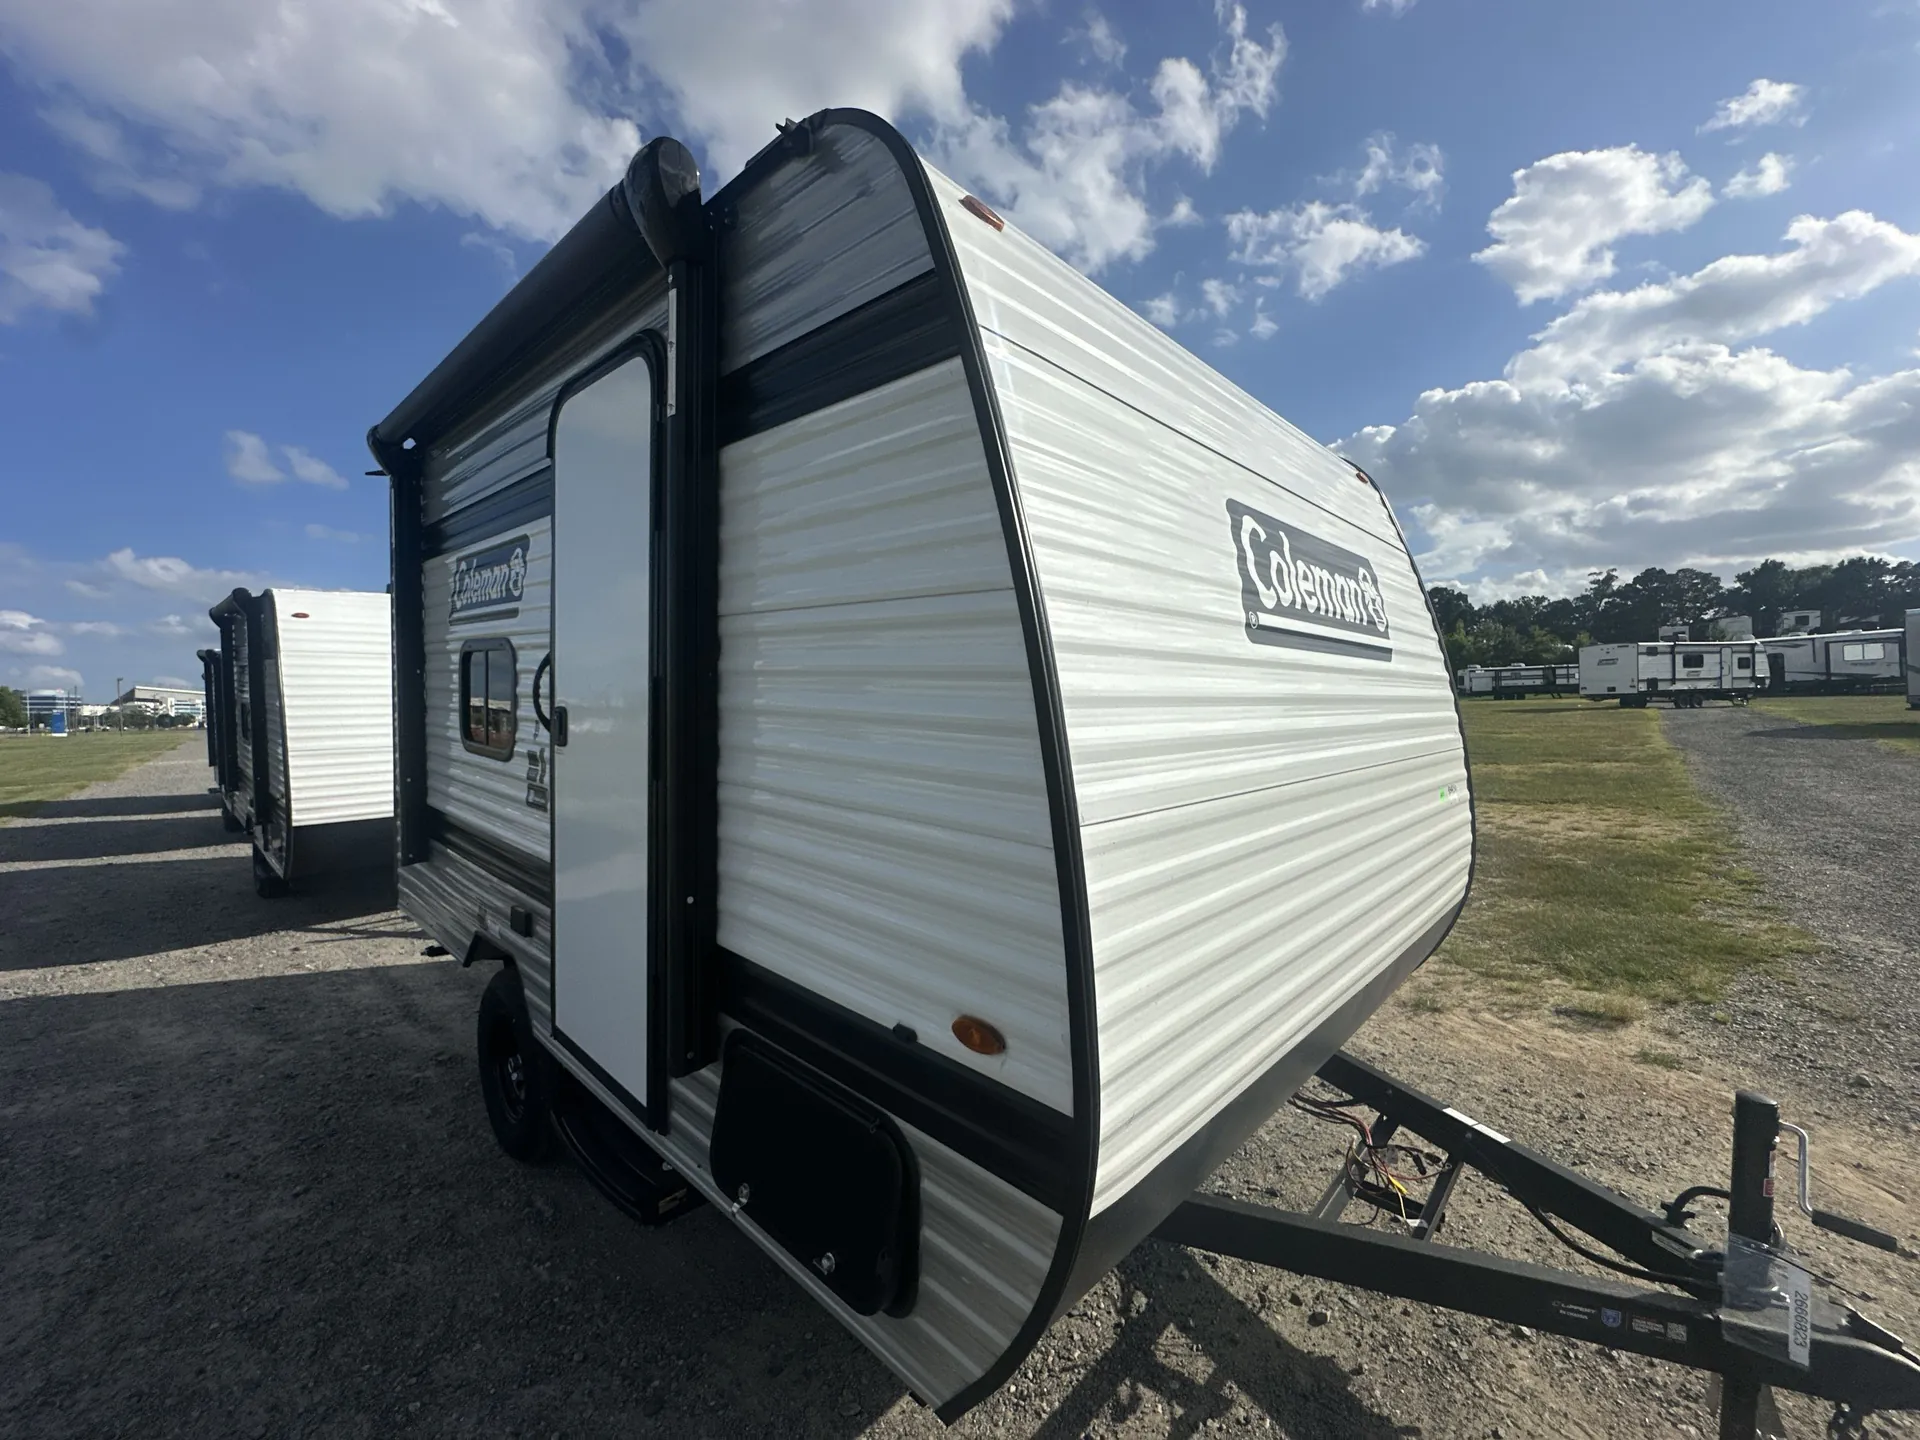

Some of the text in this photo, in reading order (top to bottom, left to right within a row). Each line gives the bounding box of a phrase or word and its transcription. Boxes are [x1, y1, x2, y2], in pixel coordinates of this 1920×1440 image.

[454, 558, 509, 609] Coleman
[1241, 515, 1368, 626] Coleman
[1794, 1290, 1809, 1348] 2666823
